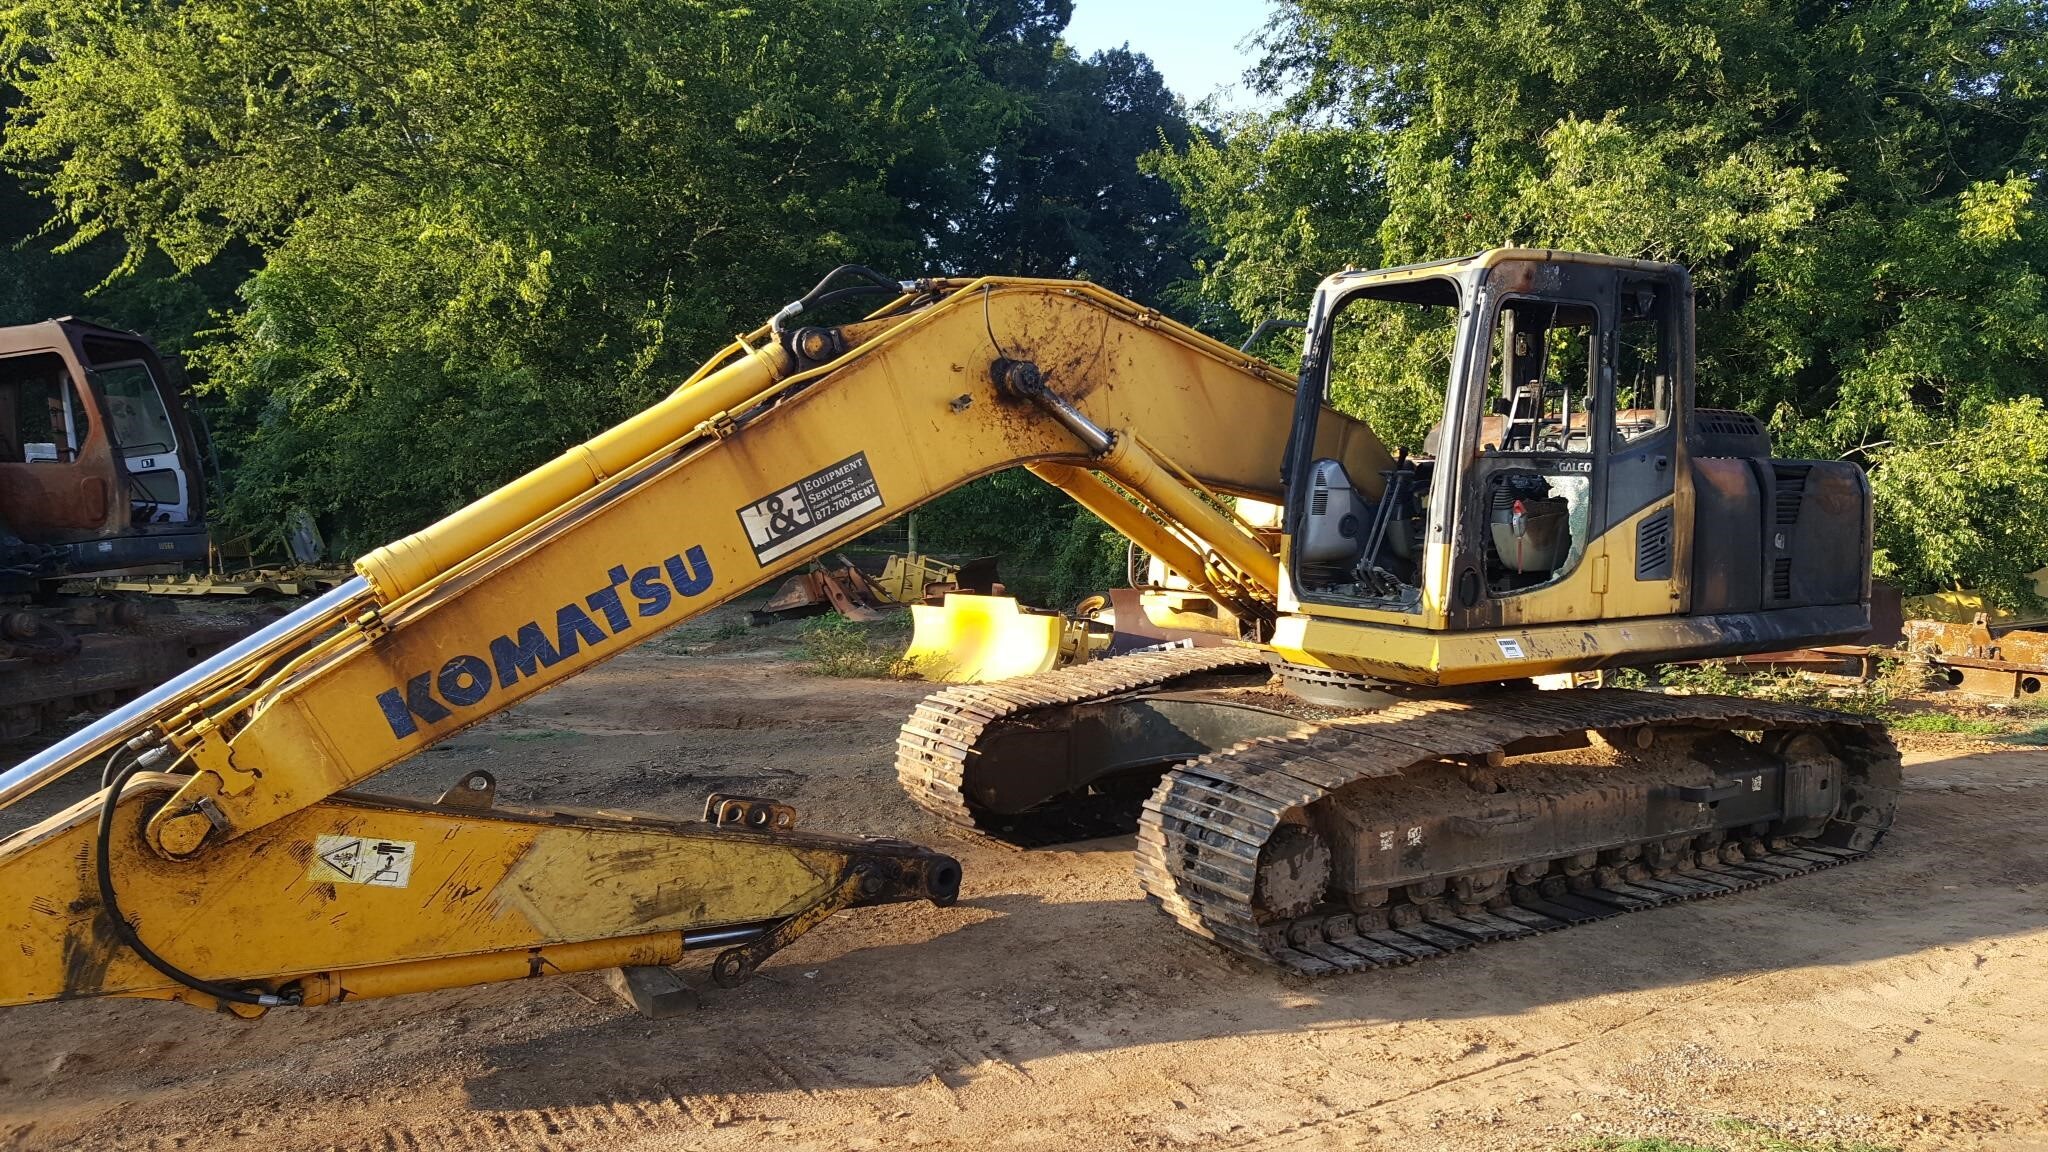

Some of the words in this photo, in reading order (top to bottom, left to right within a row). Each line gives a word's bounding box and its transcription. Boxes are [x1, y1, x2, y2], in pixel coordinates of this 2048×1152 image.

[803, 458, 863, 492] EQUIPMENT
[808, 476, 854, 503] SERVICES
[741, 487, 811, 548] H&E
[815, 483, 876, 520] 877-700-RENT
[376, 544, 714, 740] KOMATSU
